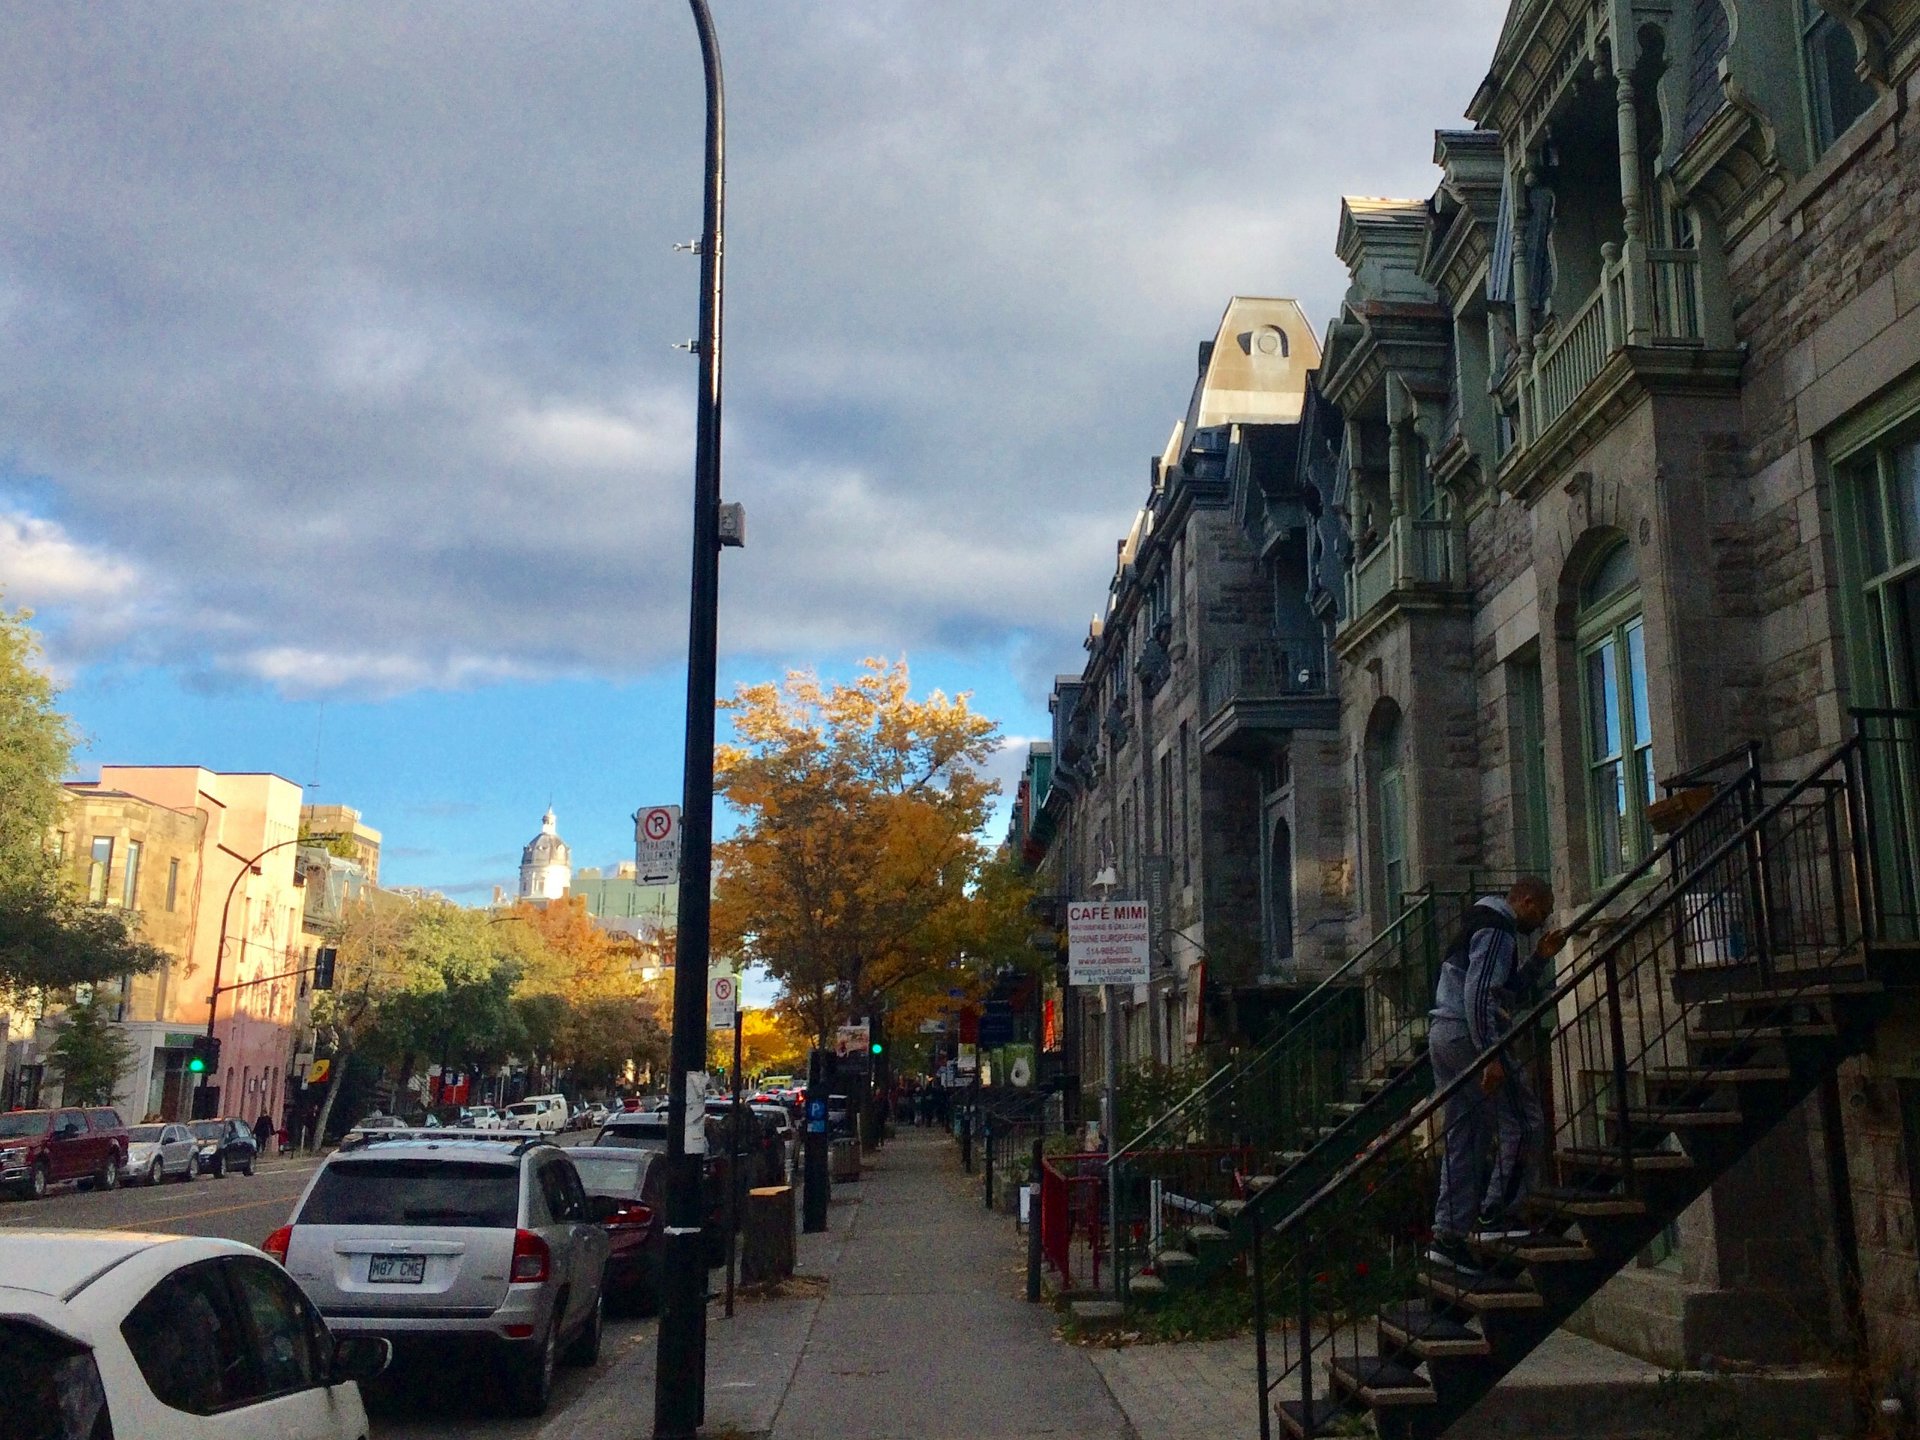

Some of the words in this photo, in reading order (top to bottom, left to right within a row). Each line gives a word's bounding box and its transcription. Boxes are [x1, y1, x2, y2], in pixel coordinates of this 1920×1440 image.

[1070, 904, 1110, 920] CAFÉ
[1114, 906, 1147, 920] MIMI
[1070, 934, 1099, 944] CUISINE
[1100, 932, 1147, 943] EUROPÉENNE
